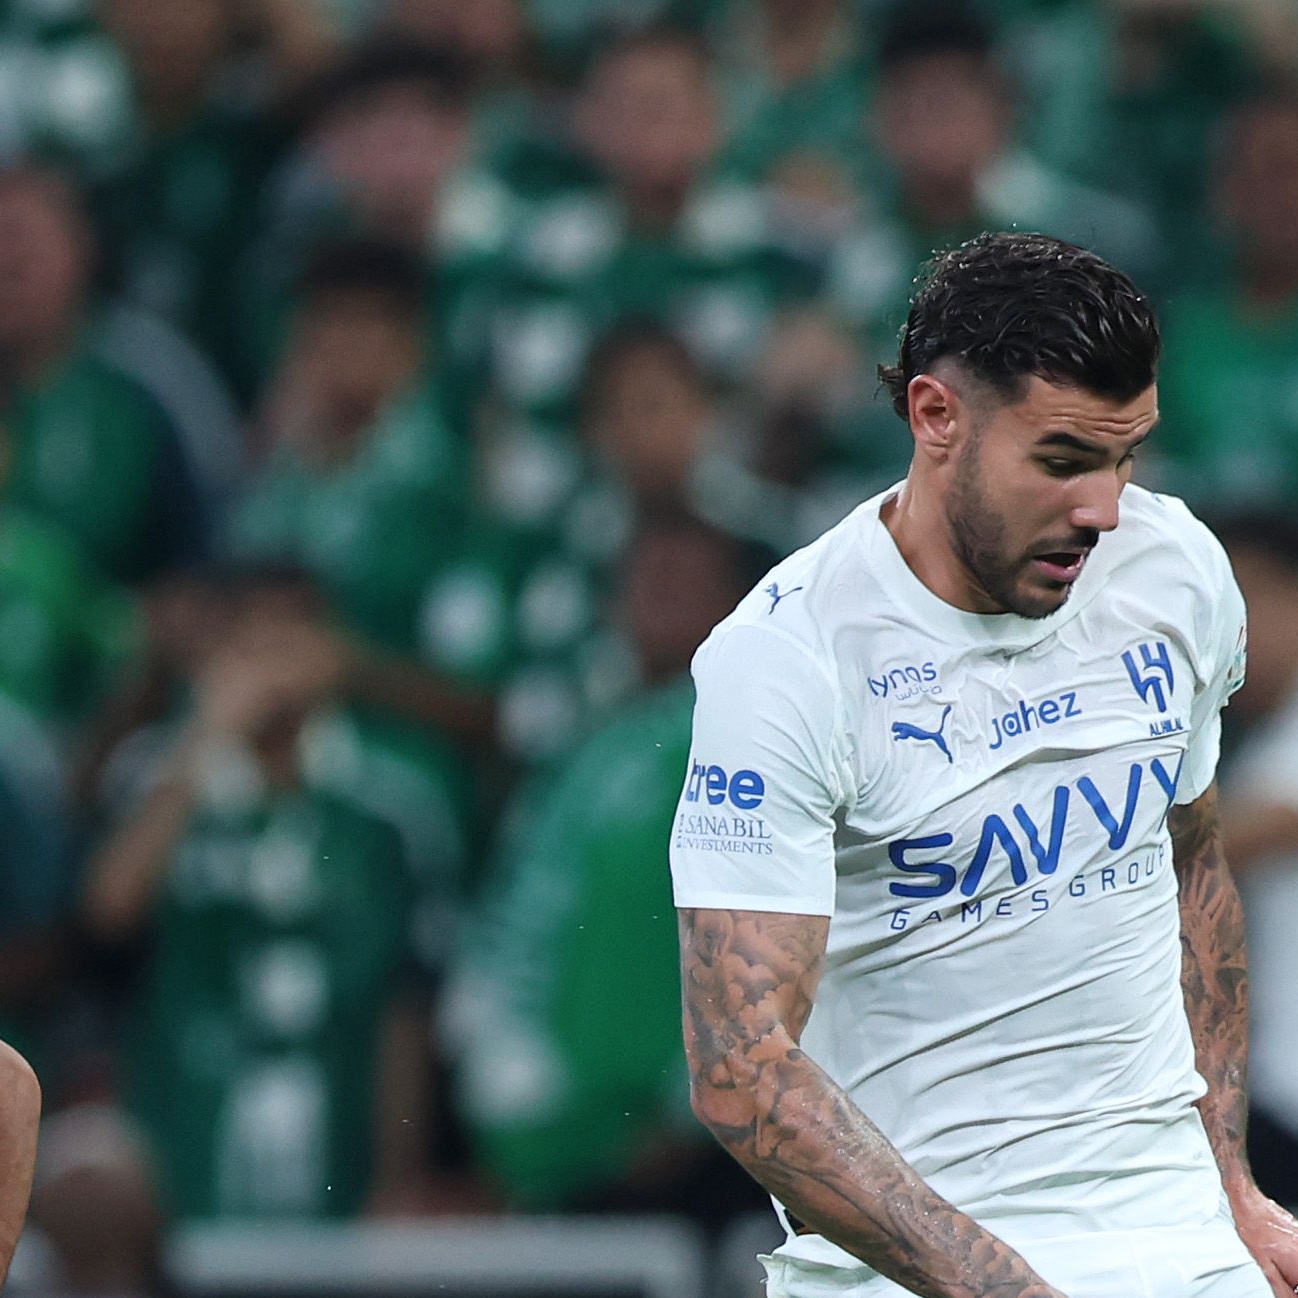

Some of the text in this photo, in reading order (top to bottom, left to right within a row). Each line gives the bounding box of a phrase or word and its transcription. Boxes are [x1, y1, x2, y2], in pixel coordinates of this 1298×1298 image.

[684, 814, 774, 840] SANABIL
[888, 749, 1184, 898] SAVVY
[890, 843, 1165, 931] GAMES GROUP
